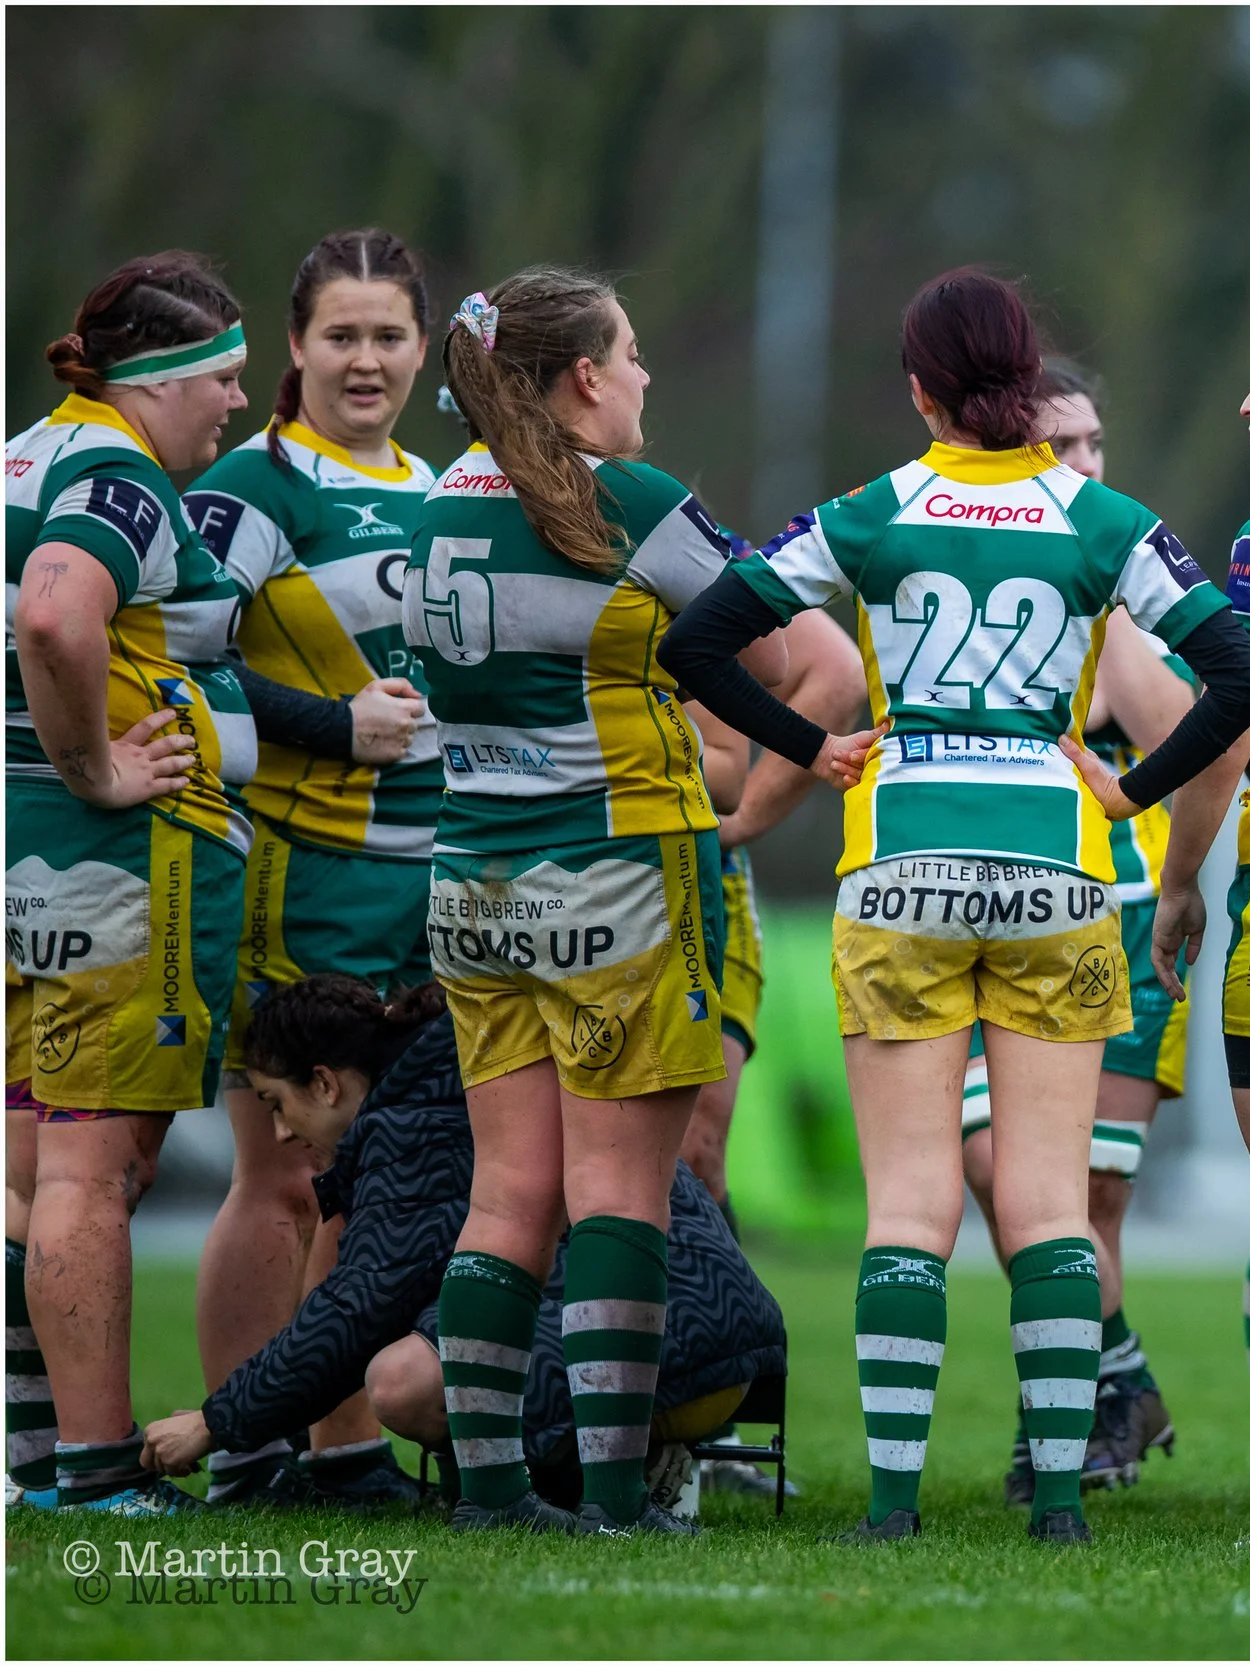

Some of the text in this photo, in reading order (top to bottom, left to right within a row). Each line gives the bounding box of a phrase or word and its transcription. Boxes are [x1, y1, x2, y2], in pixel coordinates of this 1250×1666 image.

[443, 468, 512, 494] Comp
[925, 494, 1044, 527] Compra
[349, 527, 404, 540] GILBERT
[424, 537, 494, 666] 5
[895, 570, 1068, 710] 22
[480, 765, 508, 775] Chartered
[510, 767, 521, 775] Tax
[944, 754, 1045, 766] Chartered Tax Advisers
[898, 862, 971, 881] LITTLE
[679, 843, 702, 988] MOOREMentum
[859, 885, 1105, 925] BOTTOMS UP
[32, 930, 92, 971] UP
[164, 860, 181, 1013] MOOREMentum
[550, 925, 614, 968] UP
